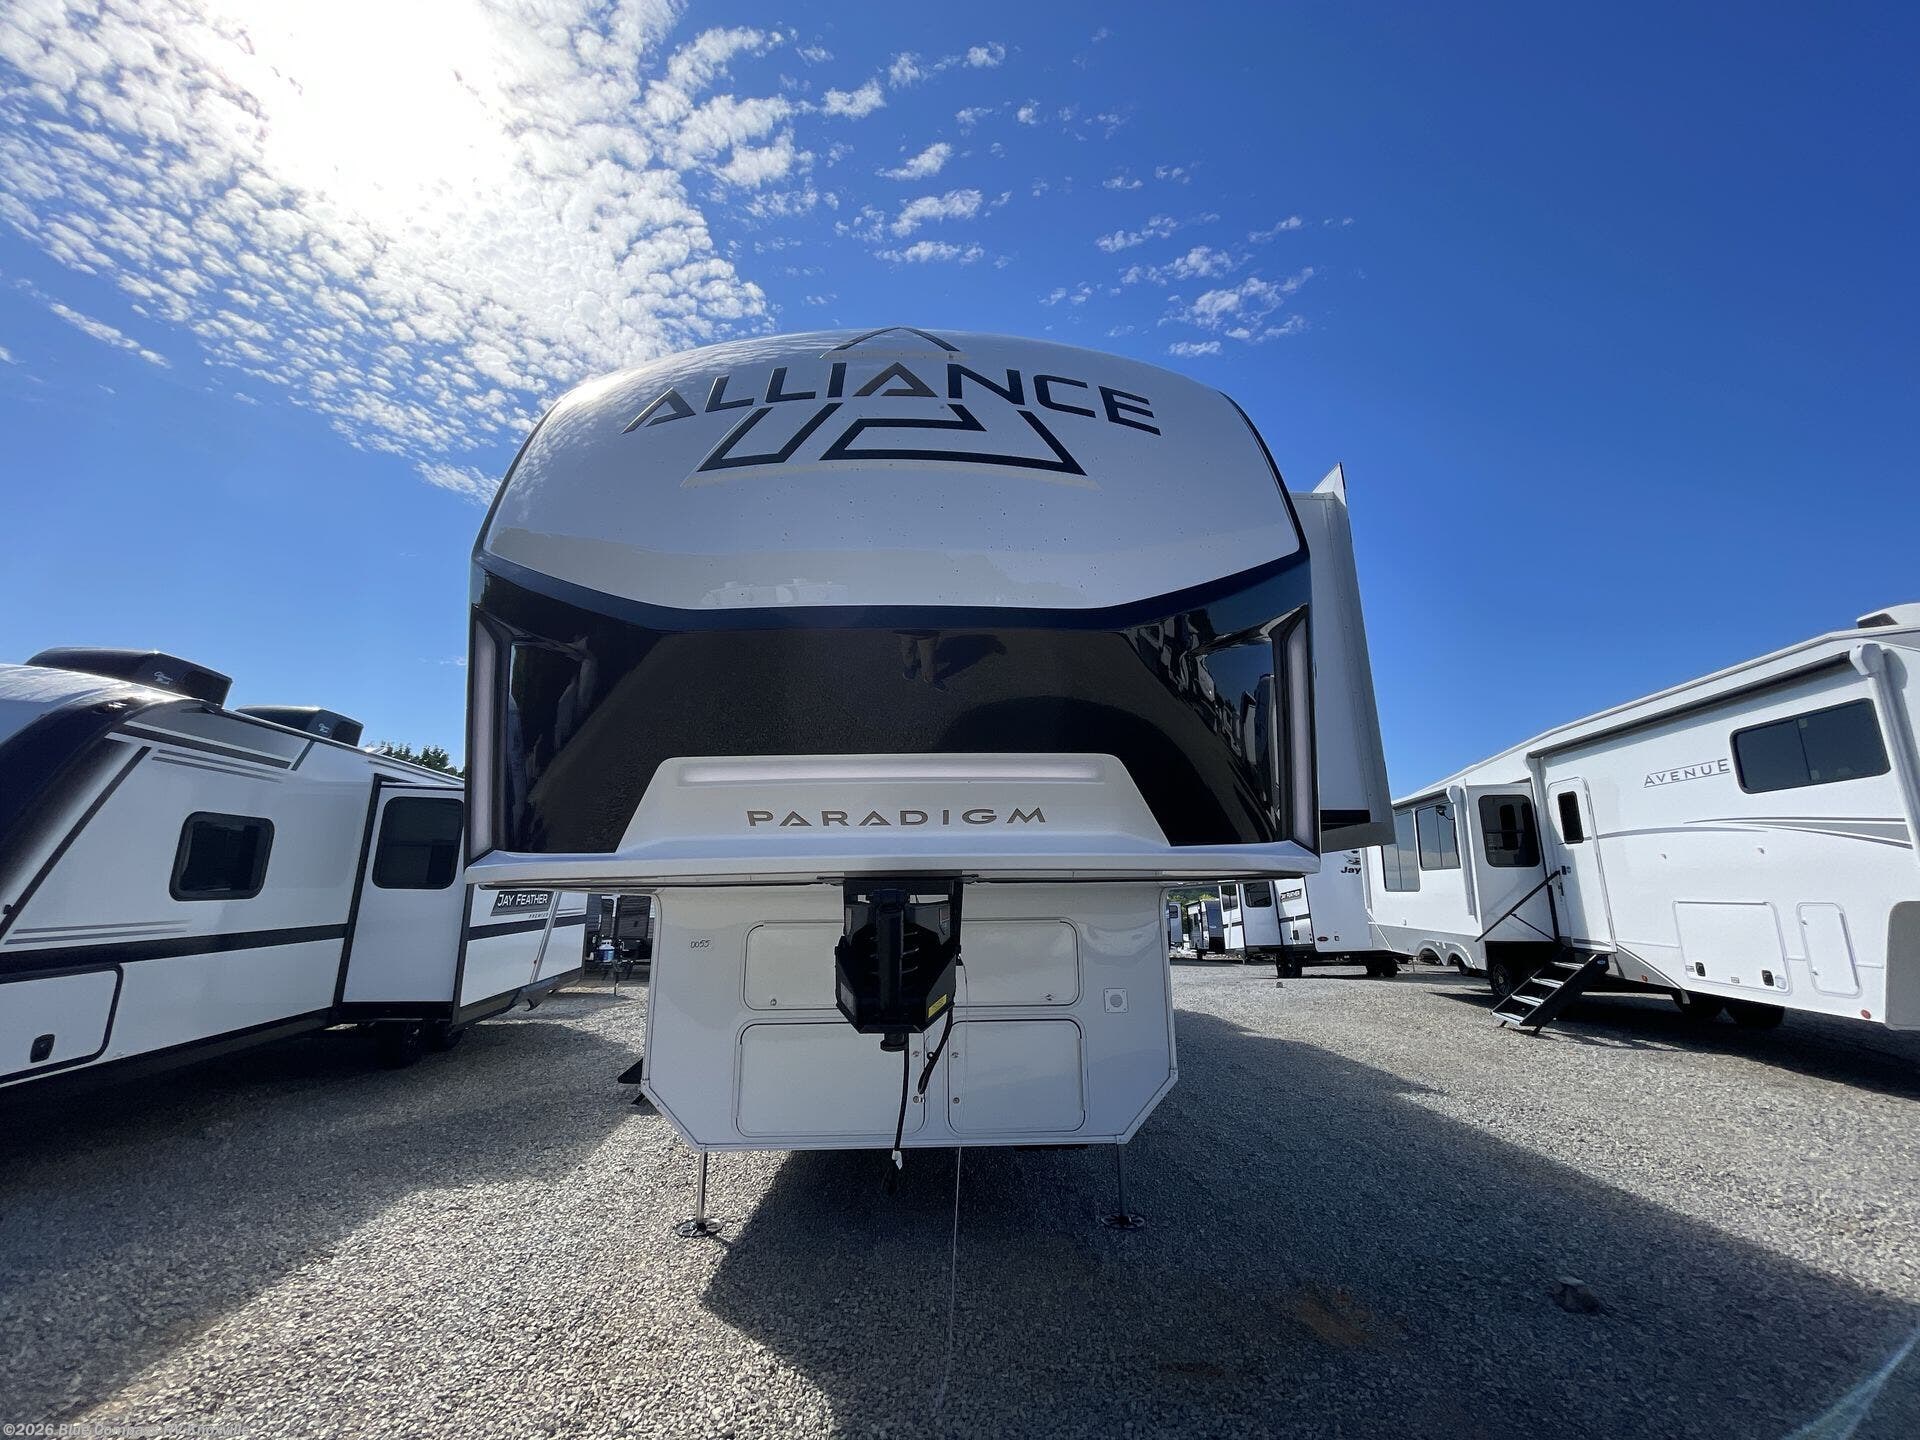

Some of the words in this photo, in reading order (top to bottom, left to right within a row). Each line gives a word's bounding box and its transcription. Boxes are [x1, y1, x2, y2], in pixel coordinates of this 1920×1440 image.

[620, 361, 1162, 436] ALLIANCE
[1644, 758, 1730, 787] AVENUE
[746, 806, 1046, 828] PARADIGM
[497, 894, 515, 907] JAY
[515, 893, 548, 906] FEATHER
